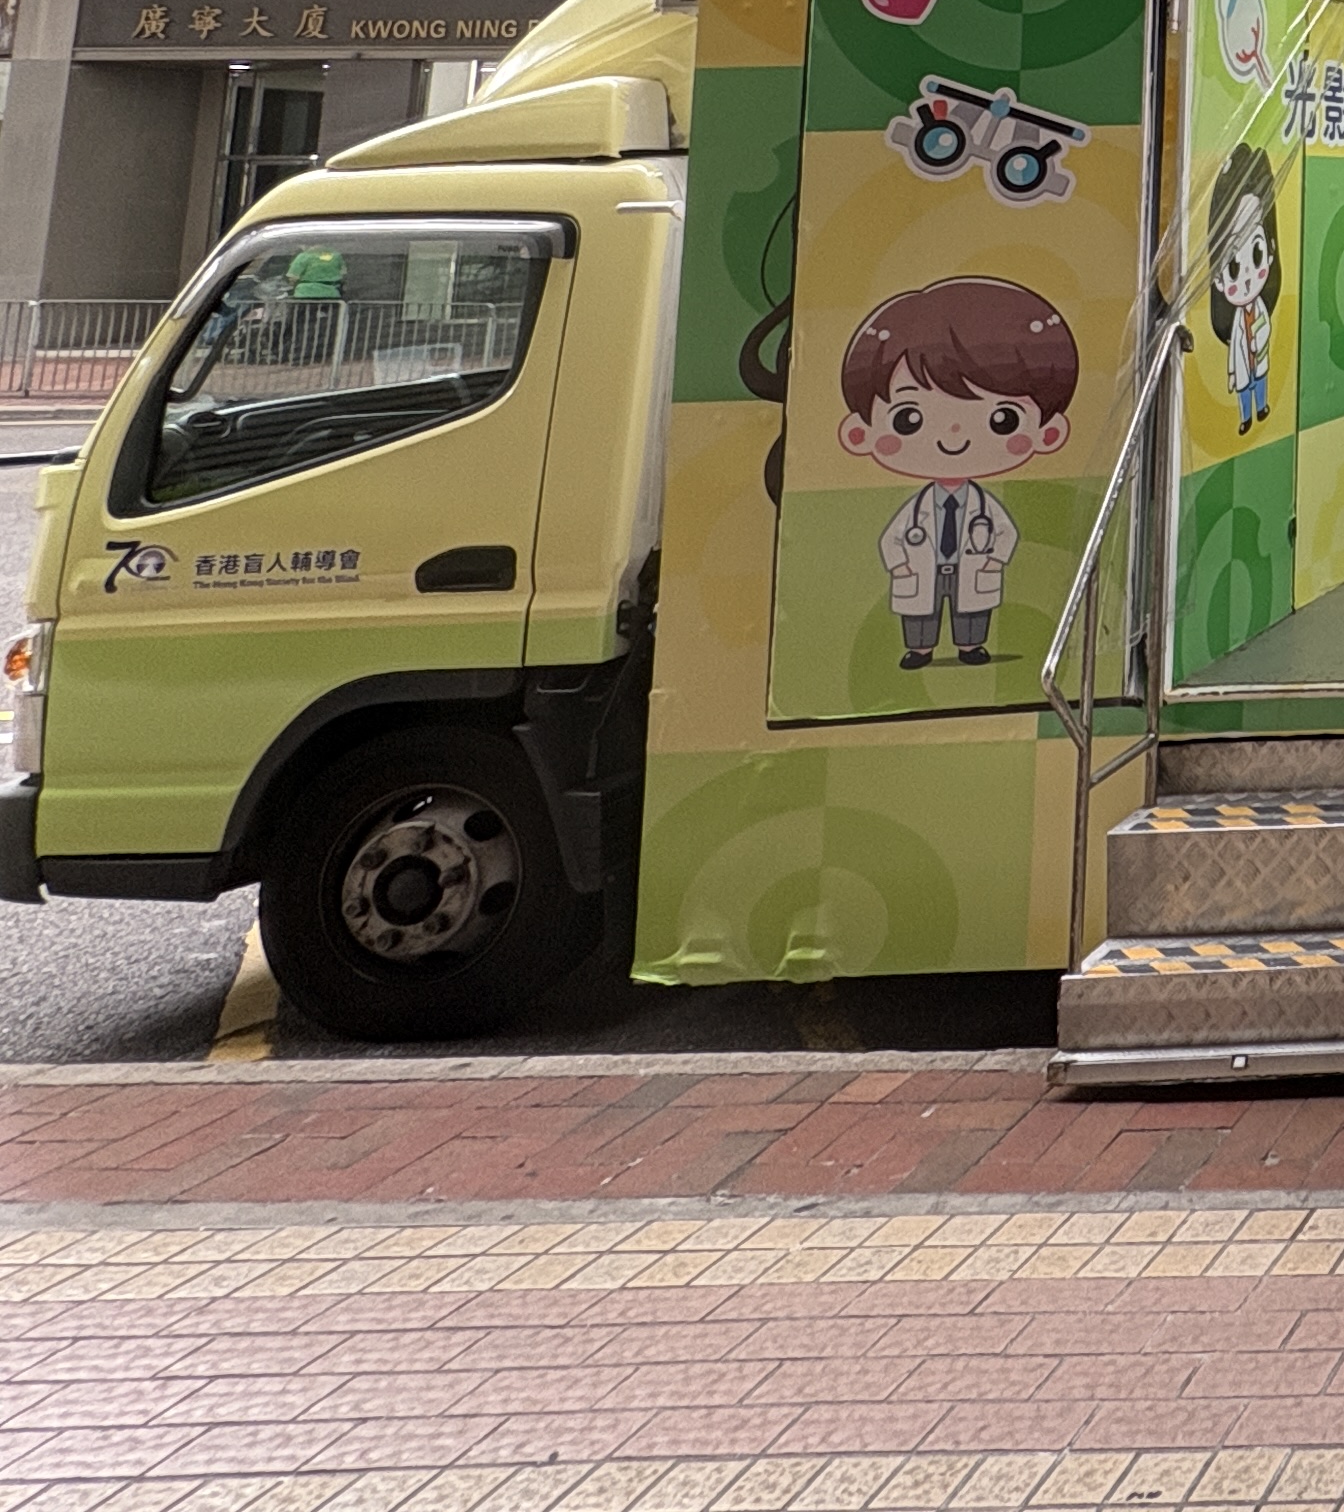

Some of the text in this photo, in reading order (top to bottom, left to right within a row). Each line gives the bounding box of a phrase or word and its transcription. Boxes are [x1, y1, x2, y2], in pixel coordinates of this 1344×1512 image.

[350, 19, 447, 39] KWONG
[455, 19, 518, 39] NING
[195, 549, 361, 576] 香港盲人輔導會
